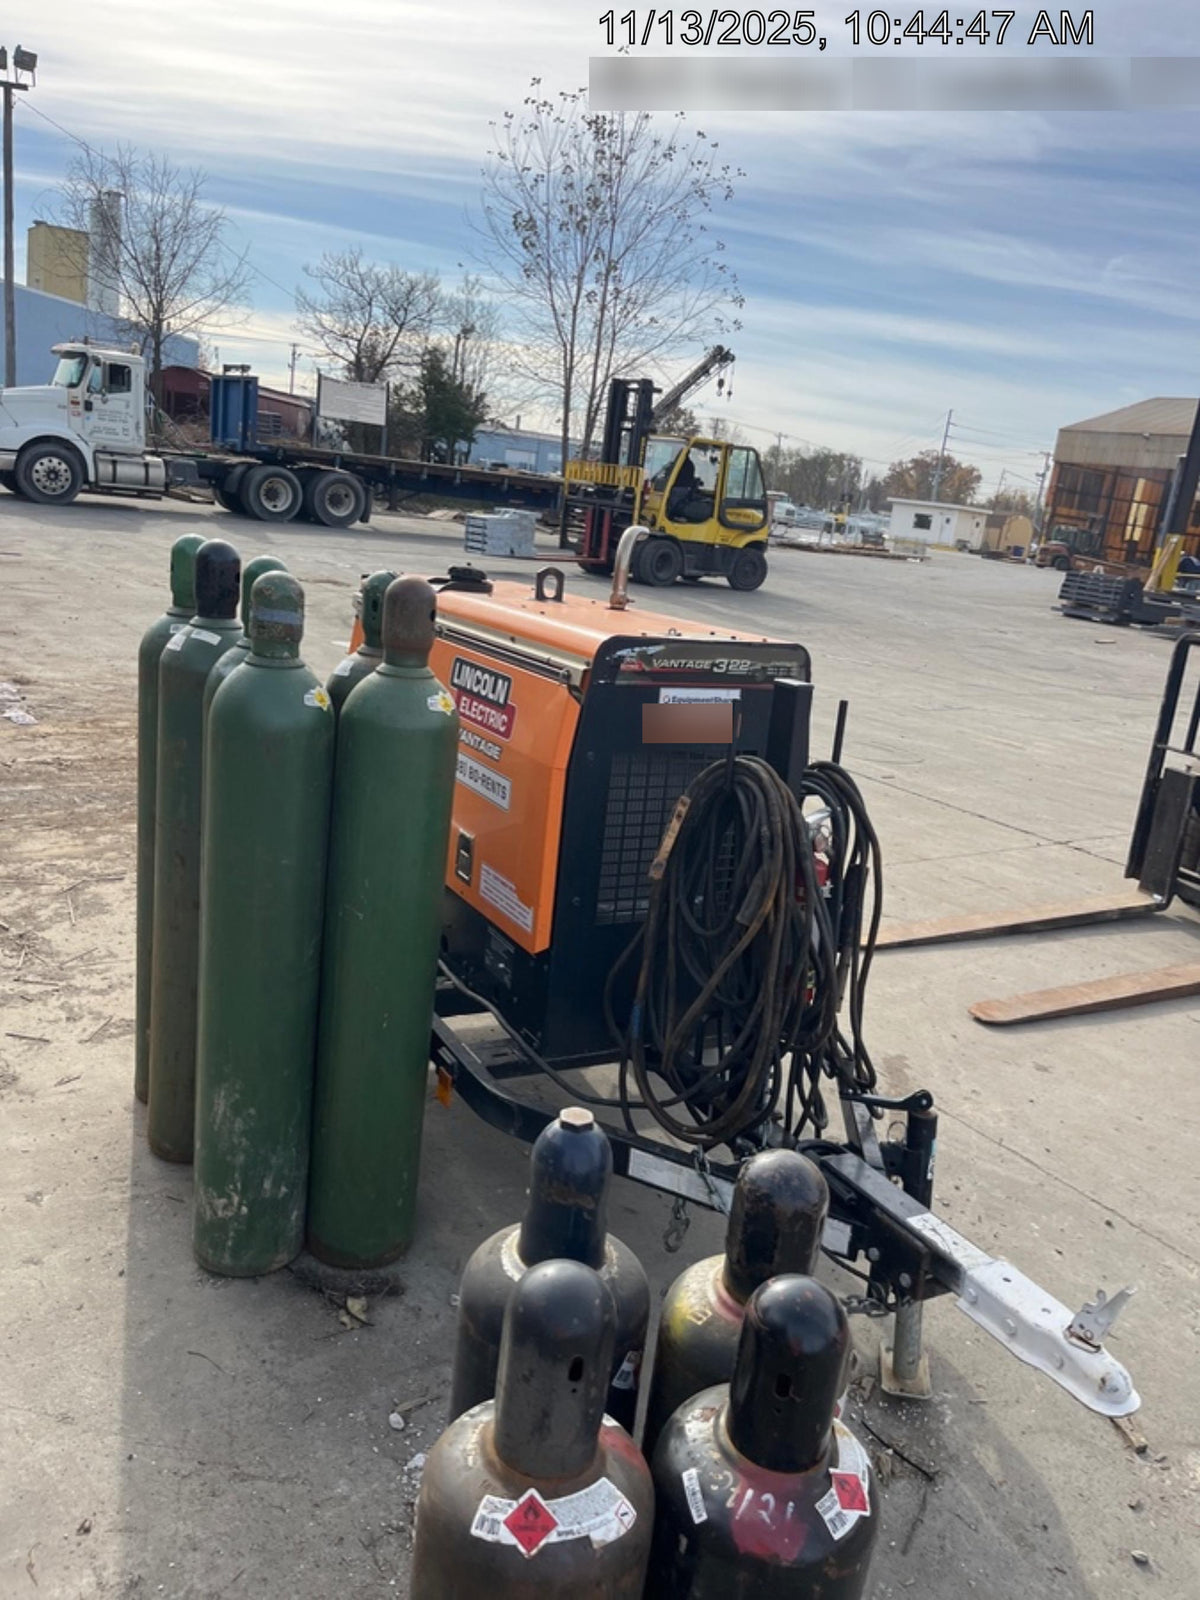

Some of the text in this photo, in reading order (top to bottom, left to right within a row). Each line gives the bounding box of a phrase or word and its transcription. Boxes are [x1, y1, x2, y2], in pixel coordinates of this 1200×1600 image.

[452, 662, 509, 705] LINCOLN
[652, 658, 713, 670] VANTAGE
[712, 657, 752, 674] 322
[459, 696, 509, 733] ELECTRIC
